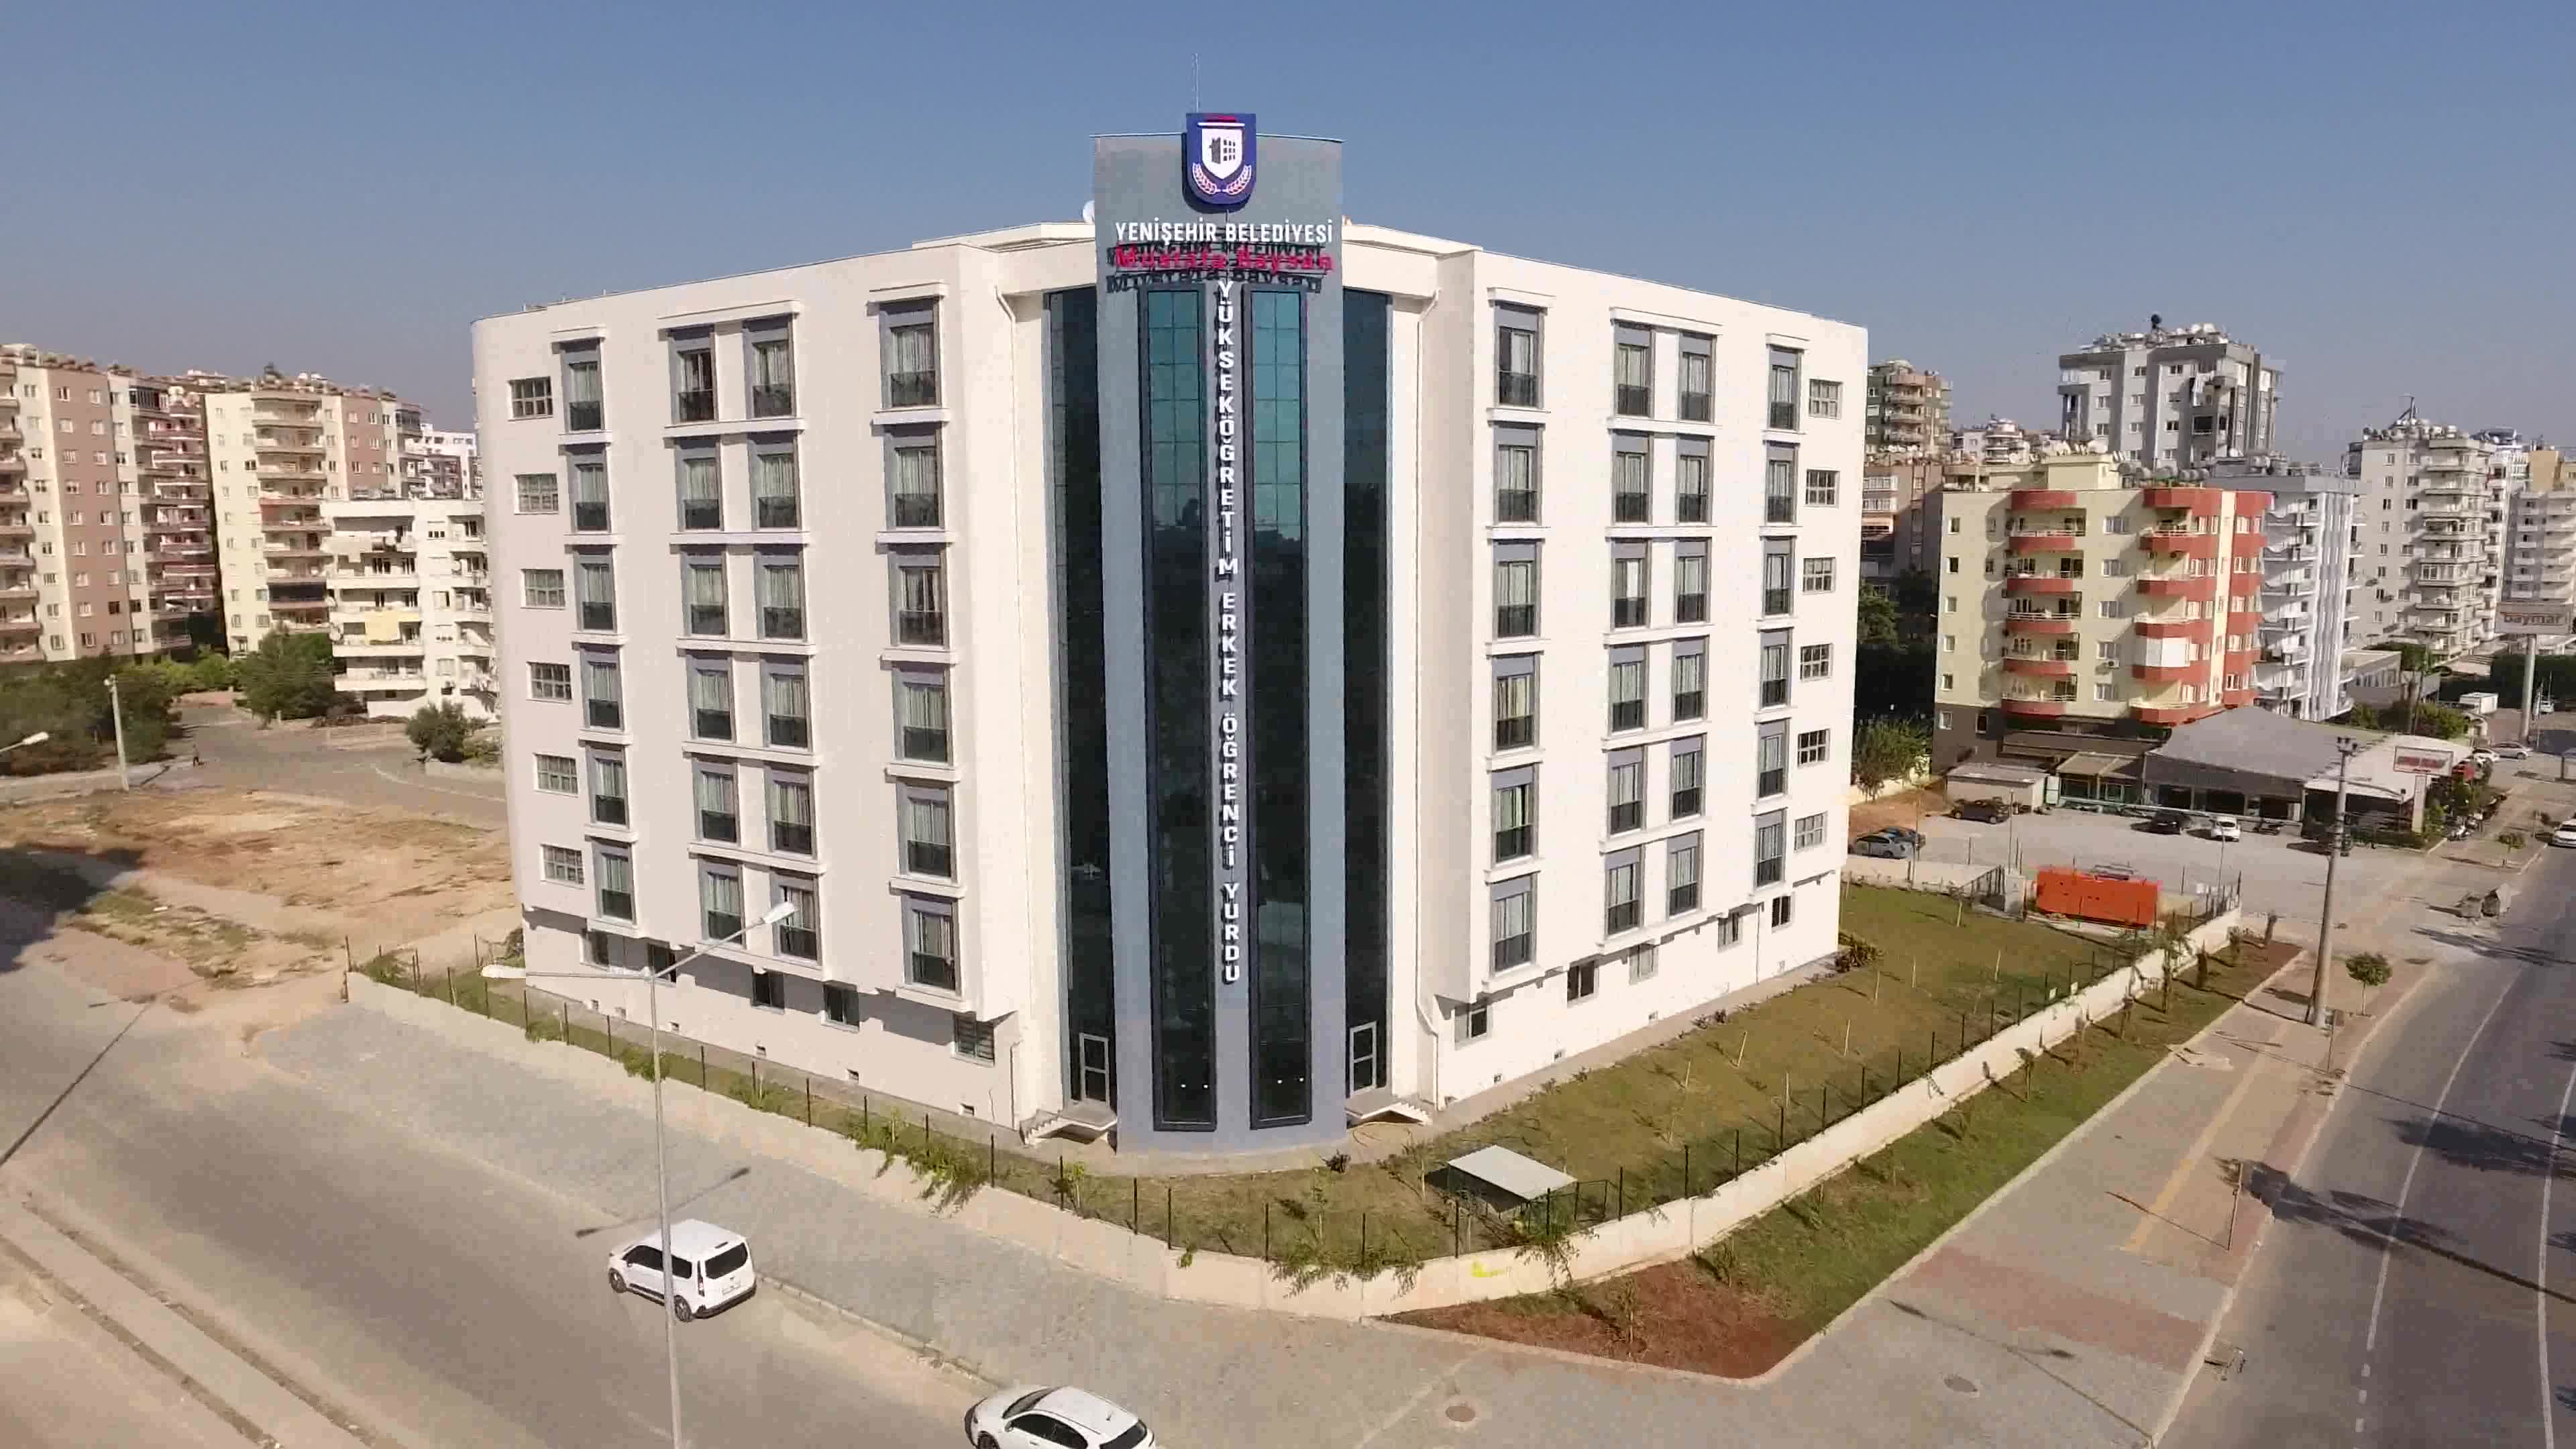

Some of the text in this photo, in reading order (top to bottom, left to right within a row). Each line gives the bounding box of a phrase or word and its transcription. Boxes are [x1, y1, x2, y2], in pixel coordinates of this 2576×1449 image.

[1116, 217, 1332, 246] YENİŞEHİR BELEDİYESİ
[1218, 280, 1240, 982] YÜKSEKÖĞRETİM ERKEK ÖĞRENCİ YURDU
